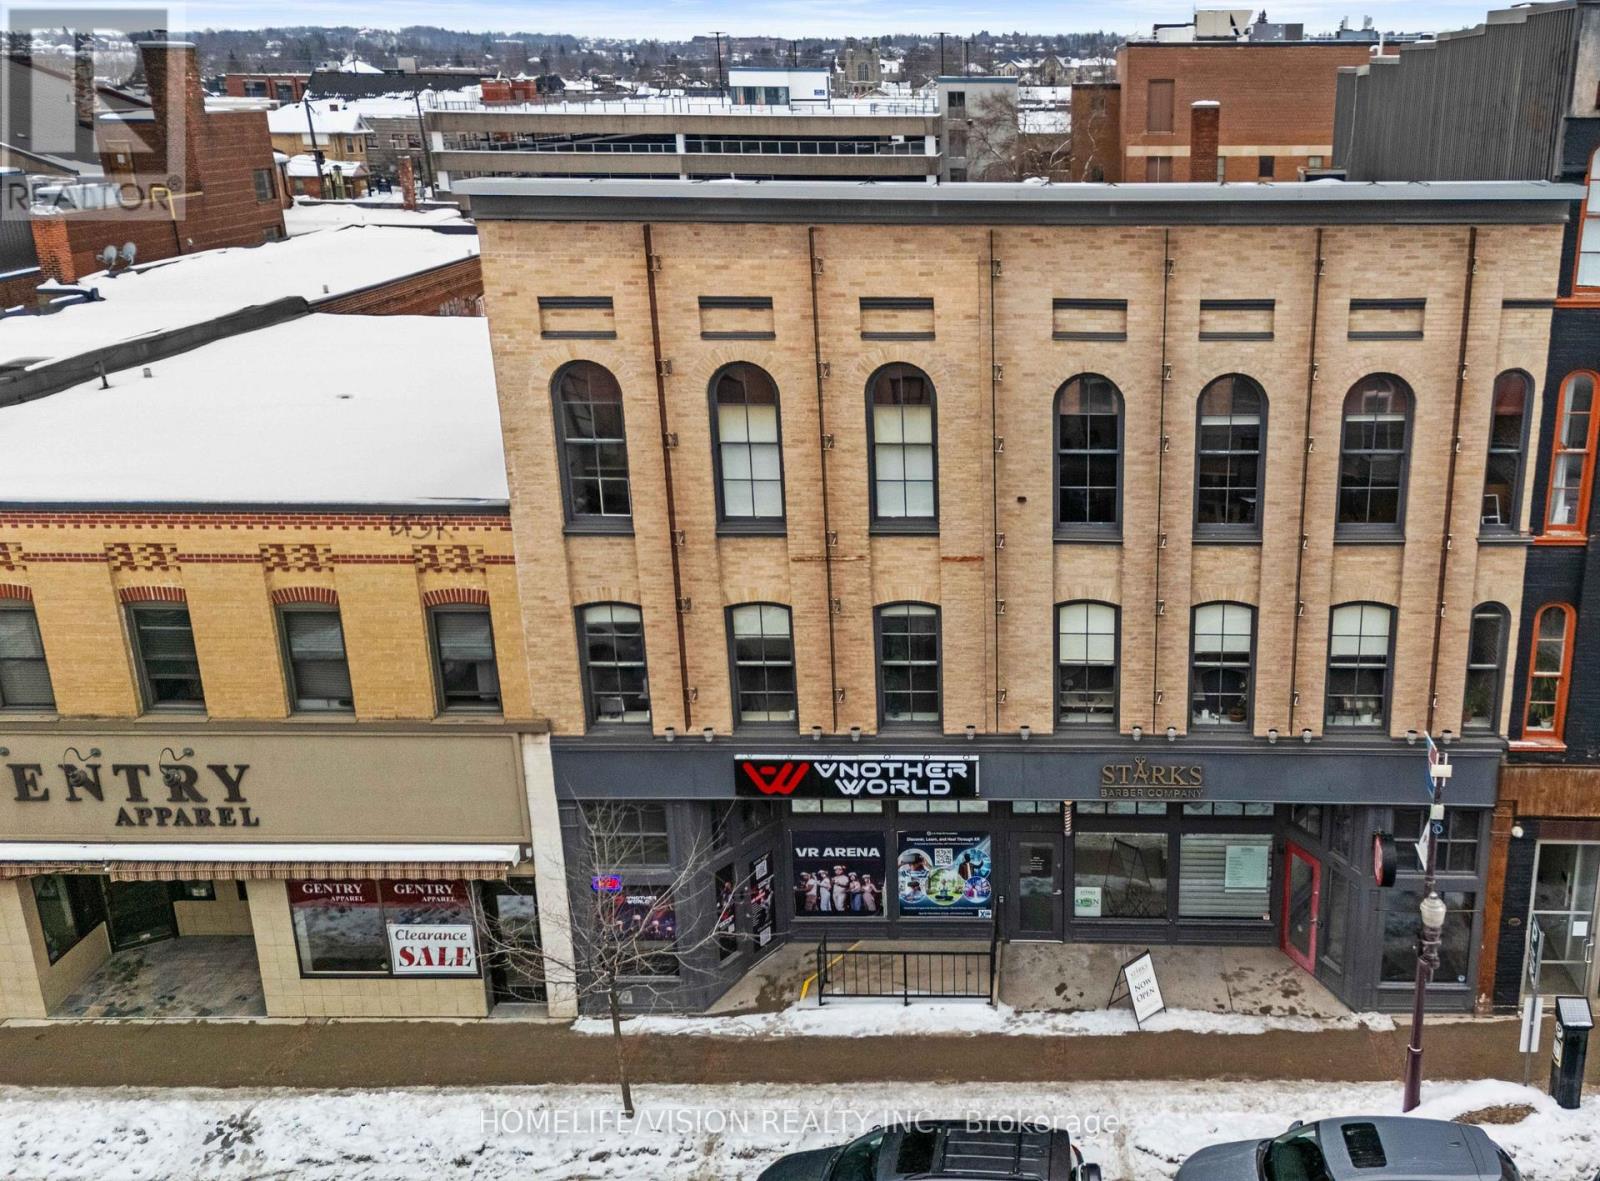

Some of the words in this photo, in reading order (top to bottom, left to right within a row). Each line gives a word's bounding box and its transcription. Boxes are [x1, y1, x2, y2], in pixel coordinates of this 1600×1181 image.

[1102, 757, 1202, 785] STARKS
[834, 779, 951, 795] WORLD
[1101, 789, 1143, 798] BARBER
[1147, 789, 1204, 798] COMPANY
[115, 806, 260, 827] APPAREL
[795, 847, 820, 858] VR
[822, 847, 881, 858] ARENA
[302, 883, 362, 895] GENTRY
[393, 883, 455, 895] GENTRY
[395, 928, 467, 941] Clearance
[399, 945, 472, 967] SALE
[1134, 976, 1152, 992] NOW
[1136, 988, 1155, 1003] OPEN
